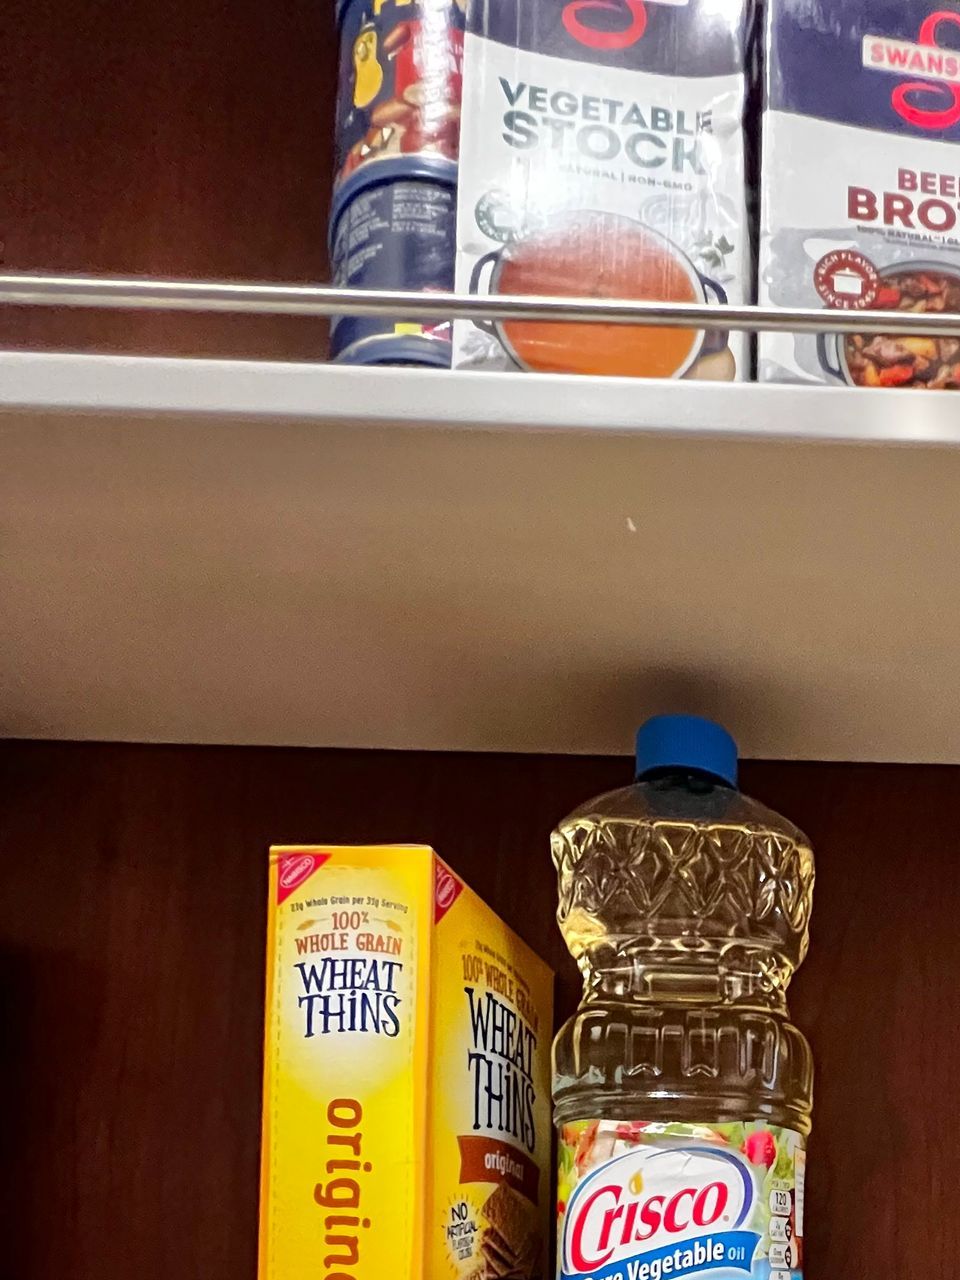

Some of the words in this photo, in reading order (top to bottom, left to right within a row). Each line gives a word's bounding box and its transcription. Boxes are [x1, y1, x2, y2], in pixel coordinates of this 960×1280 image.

[499, 76, 713, 134] VEGETABLE
[502, 110, 706, 175] STOCK
[841, 252, 878, 280] FLAVOR
[818, 285, 849, 309] SINCE
[330, 895, 350, 905] Grain
[352, 896, 364, 906] per
[381, 898, 409, 914] Serving
[331, 911, 369, 931] 100%
[294, 932, 349, 956] WHOLE
[355, 932, 403, 956] GRAIN
[293, 957, 403, 995] WHEAT
[464, 986, 538, 1085] WHEAT
[484, 1150, 524, 1181] original
[452, 1202, 468, 1221] NO
[775, 1192, 787, 1206] 120
[571, 1181, 729, 1273] Crisco
[728, 1246, 745, 1261] Oil
